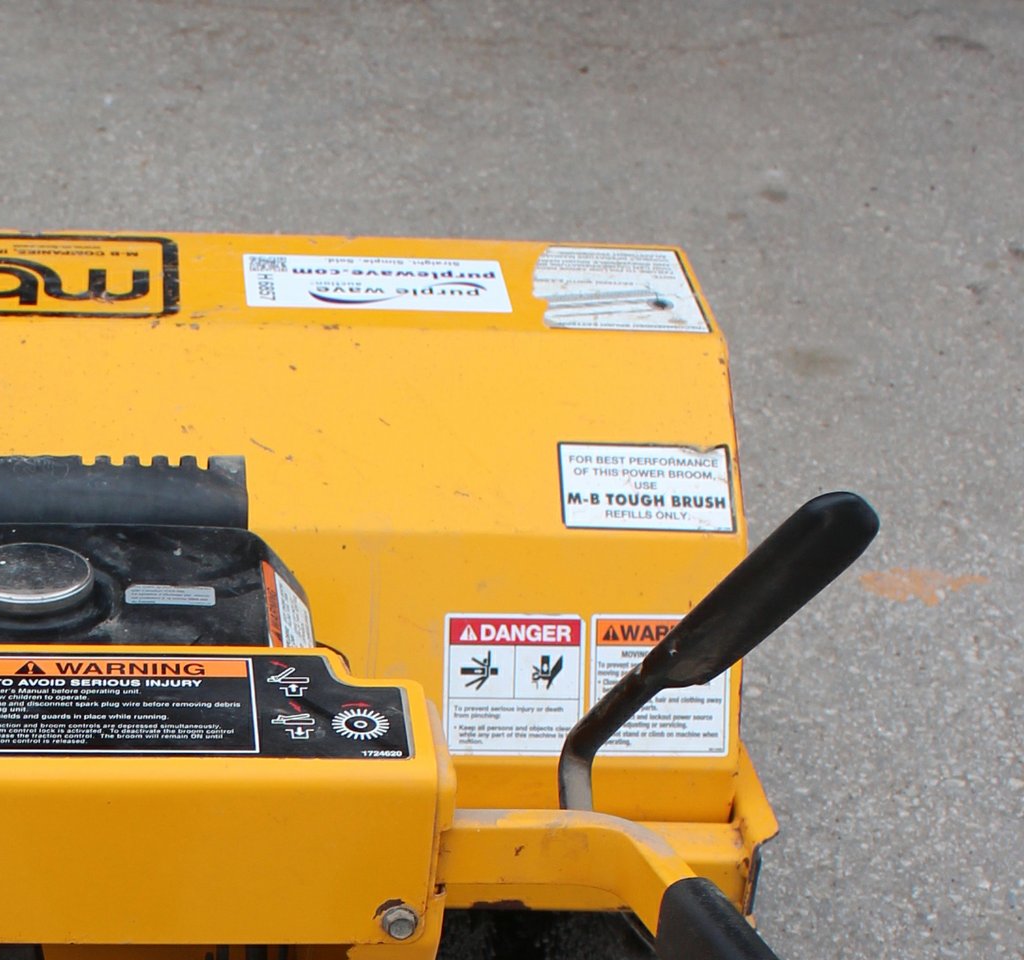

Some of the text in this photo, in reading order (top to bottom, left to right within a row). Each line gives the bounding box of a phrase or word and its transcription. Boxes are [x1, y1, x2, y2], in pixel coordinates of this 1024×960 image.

[292, 268, 495, 279] purplewave.com
[396, 287, 480, 297] purple
[568, 455, 719, 468] FOR BEST PERFORMANCE
[573, 467, 589, 476] OF
[593, 468, 619, 477] THIS
[622, 469, 665, 478] POWER
[634, 481, 658, 490] USE
[567, 493, 727, 509] M-B TOUGH BRUSH
[605, 509, 653, 519] REFILLS
[480, 624, 572, 642] DANGER
[55, 662, 206, 675] WARNING
[18, 679, 66, 687] AVOID
[70, 679, 141, 687] SERIOUS
[145, 679, 203, 687] INJURY
